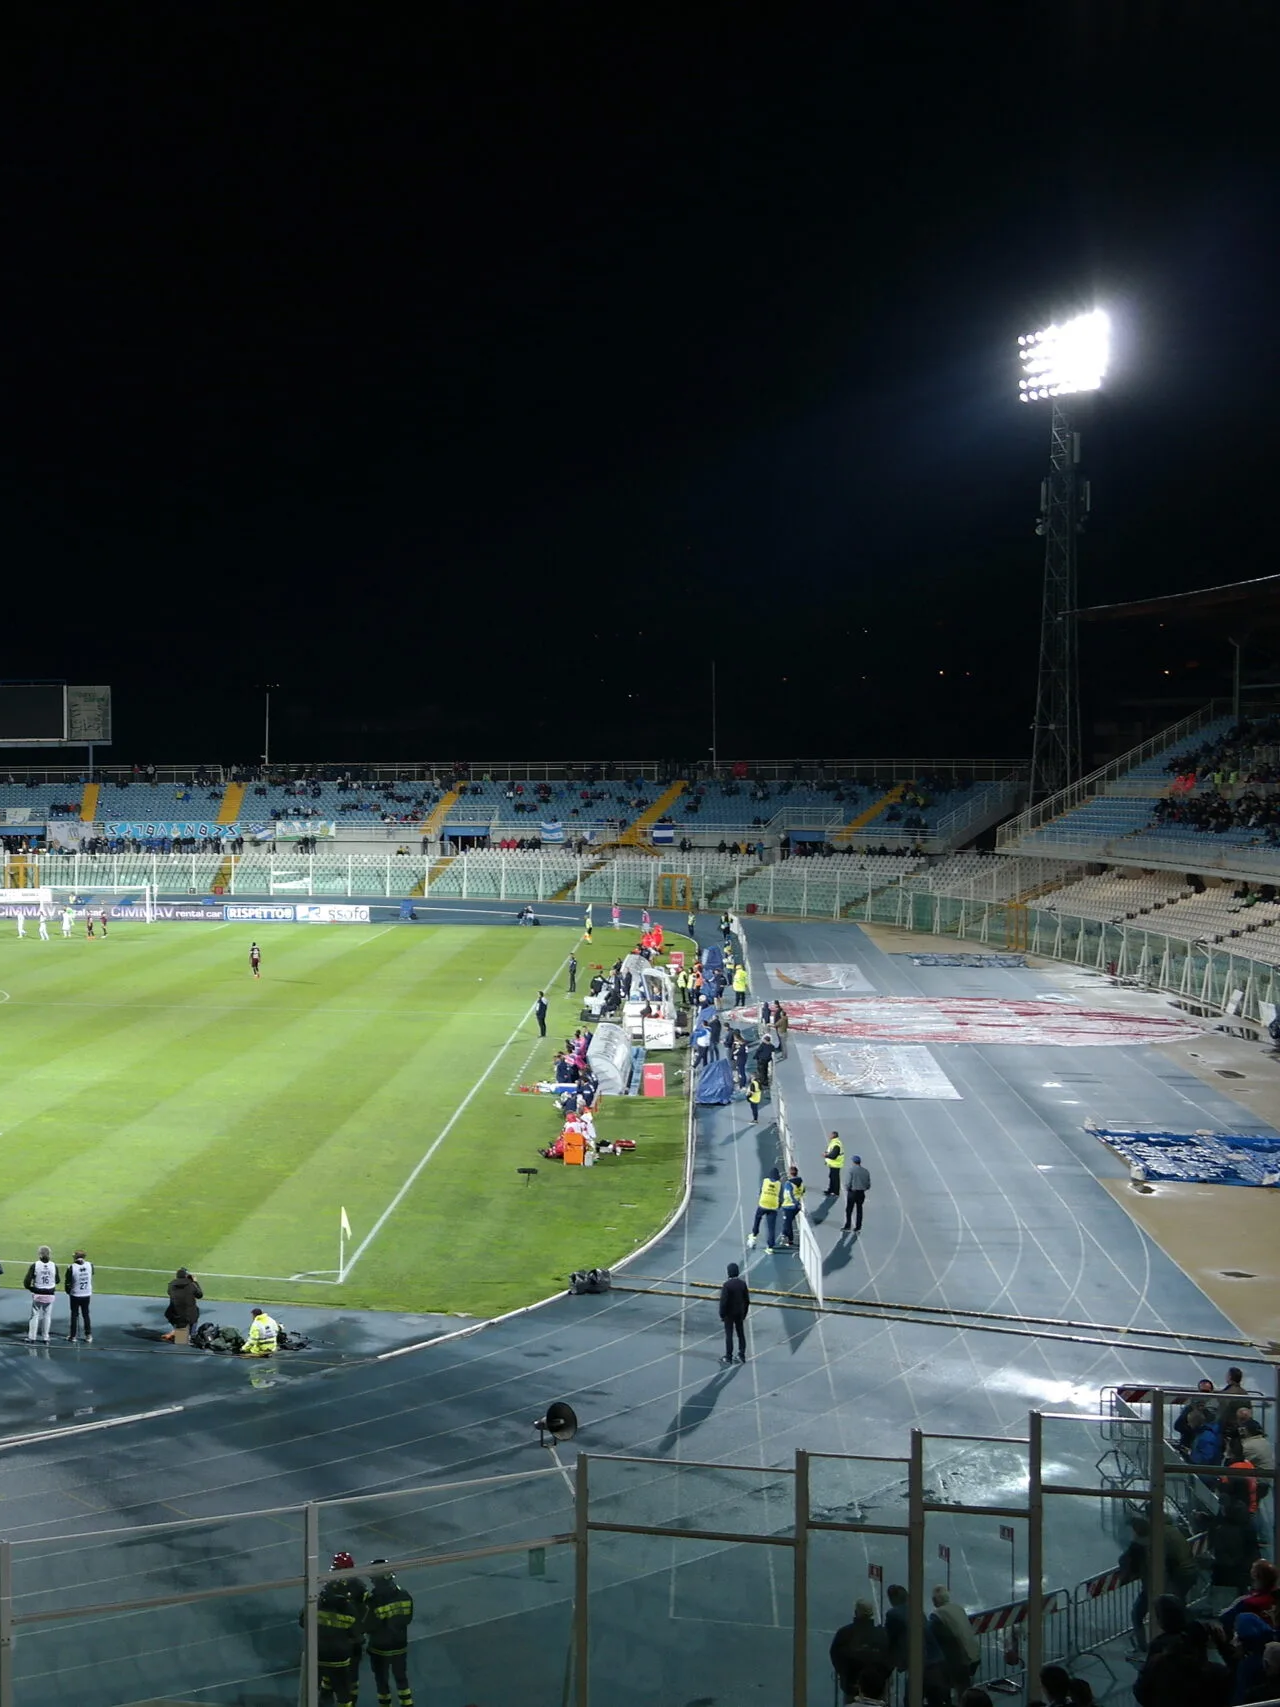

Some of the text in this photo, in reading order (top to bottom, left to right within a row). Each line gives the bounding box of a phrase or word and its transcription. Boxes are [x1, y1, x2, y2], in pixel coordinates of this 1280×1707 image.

[176, 909, 204, 918] rental
[206, 910, 222, 918] car
[41, 1275, 50, 1284] 16
[79, 1281, 88, 1290] 27
